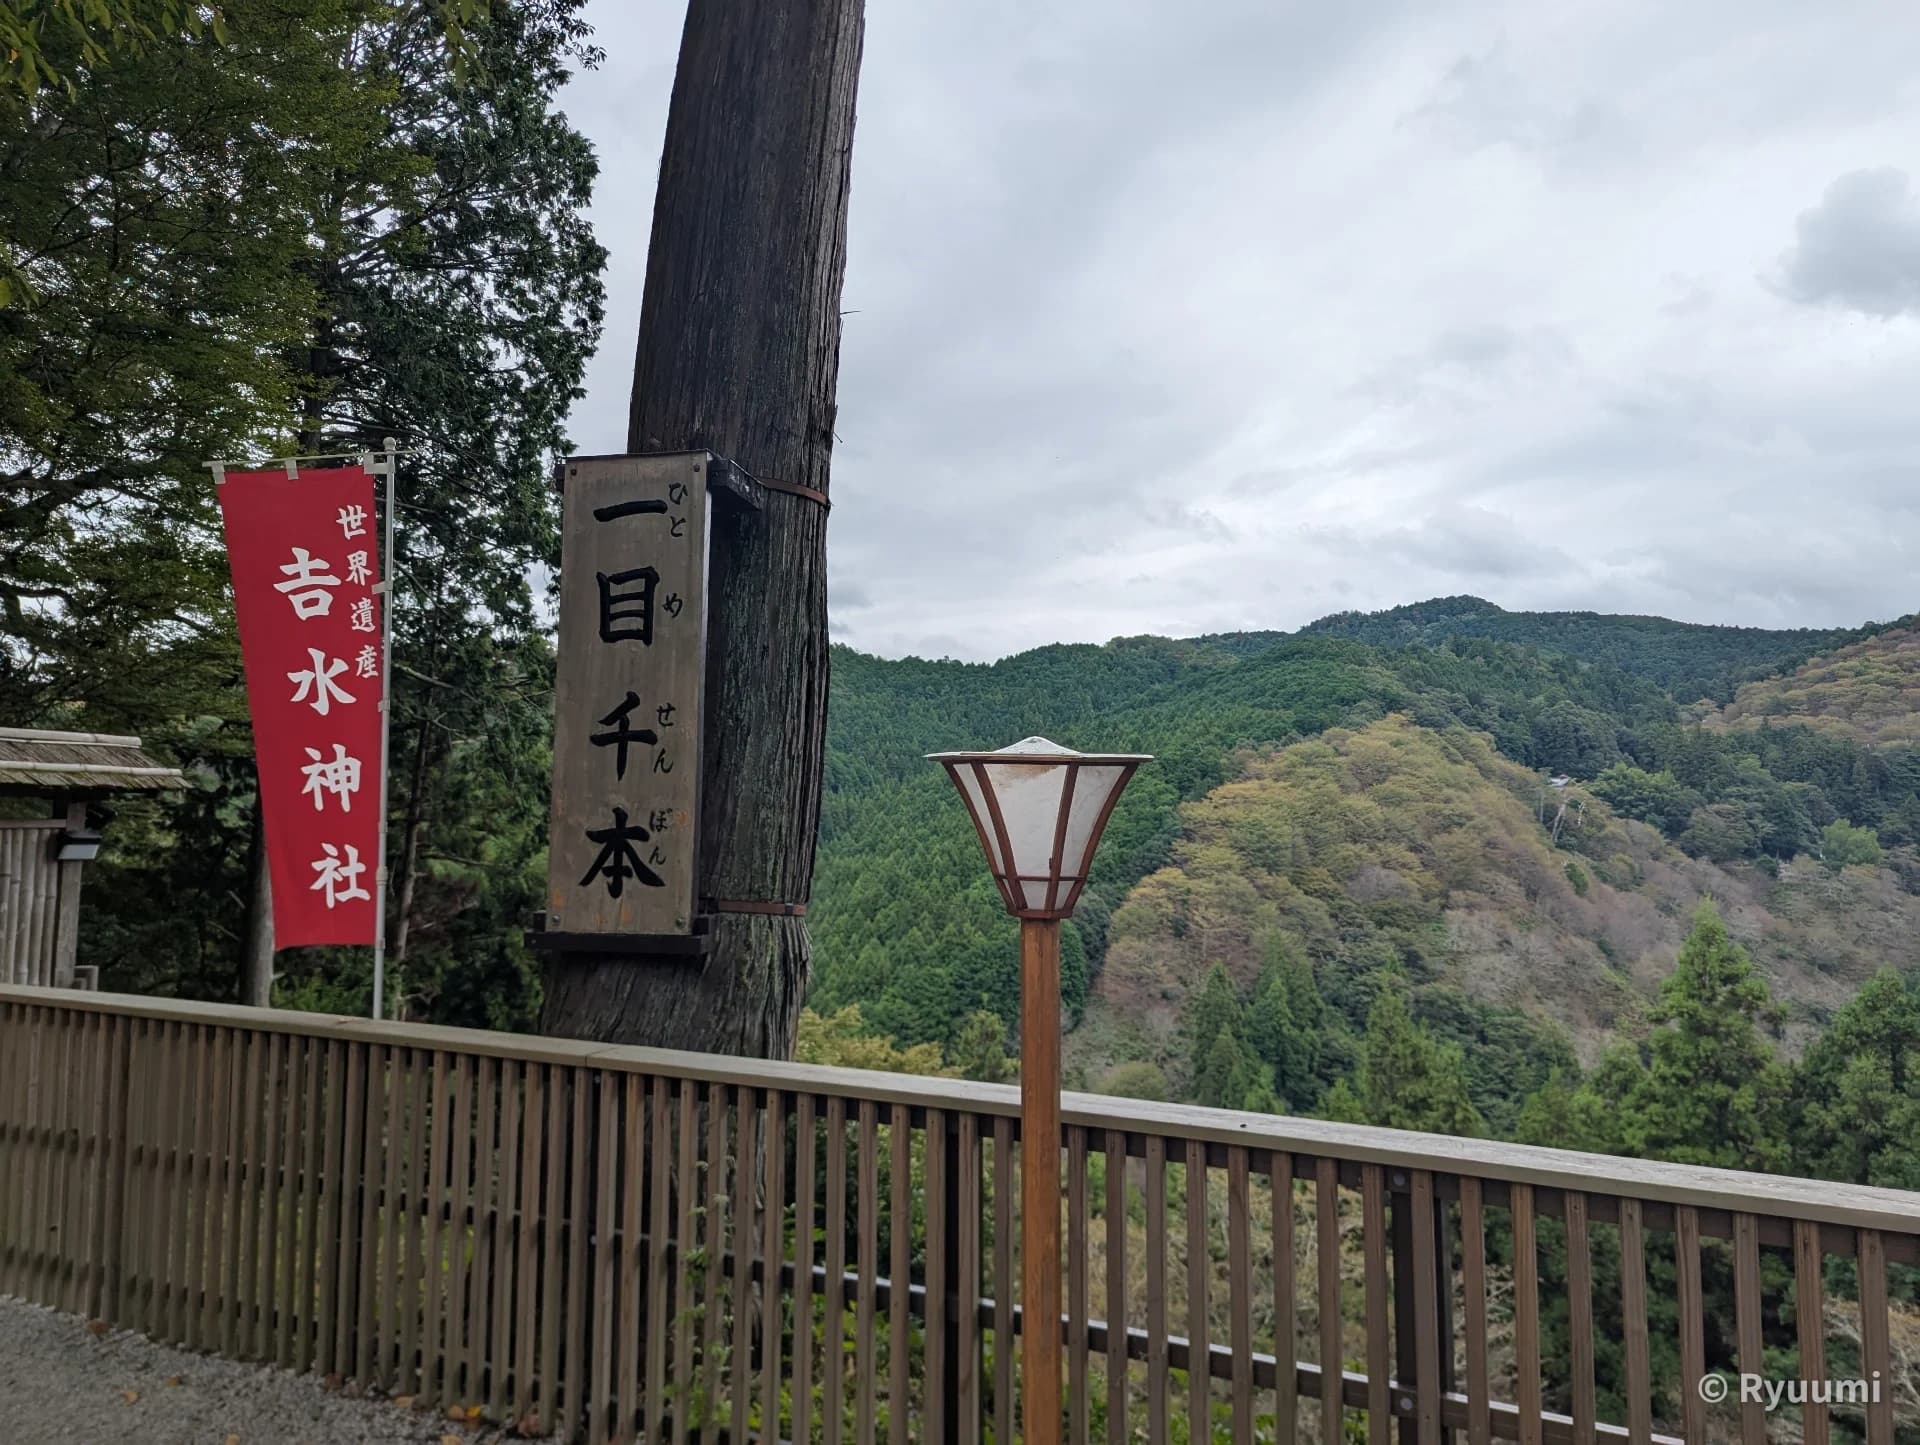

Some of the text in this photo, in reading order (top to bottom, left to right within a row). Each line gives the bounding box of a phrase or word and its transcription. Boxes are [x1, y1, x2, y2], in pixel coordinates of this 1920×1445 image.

[336, 504, 379, 678] 世界遺産
[579, 499, 668, 899] 一目千本
